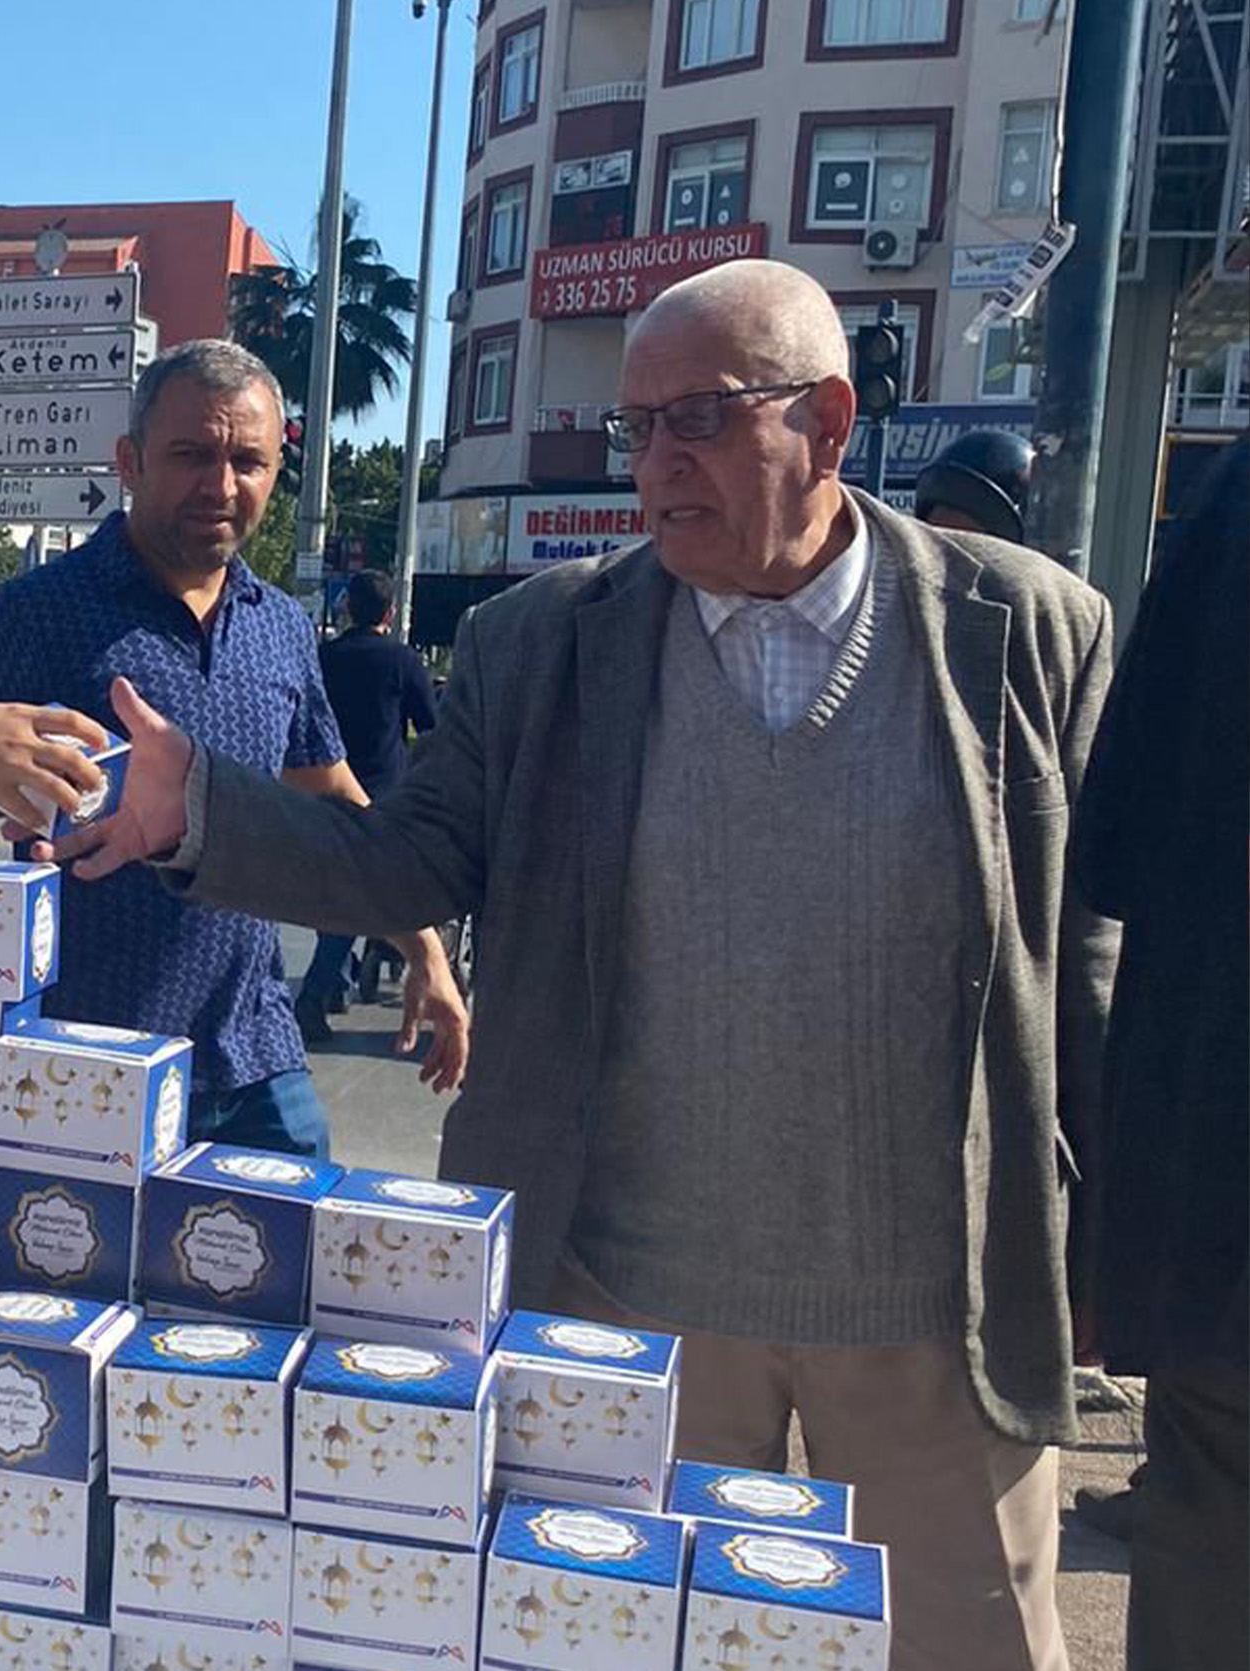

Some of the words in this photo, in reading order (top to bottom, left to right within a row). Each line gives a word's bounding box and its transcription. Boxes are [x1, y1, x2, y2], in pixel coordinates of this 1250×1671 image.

[539, 252, 602, 278] UZMAN
[608, 236, 682, 271] SÜRÜCÜ
[687, 233, 751, 262] KURSU
[33, 291, 89, 314] Sarayı
[555, 281, 585, 312] 336
[590, 279, 610, 308] 25
[616, 275, 636, 306] 75
[47, 401, 90, 424] Garı
